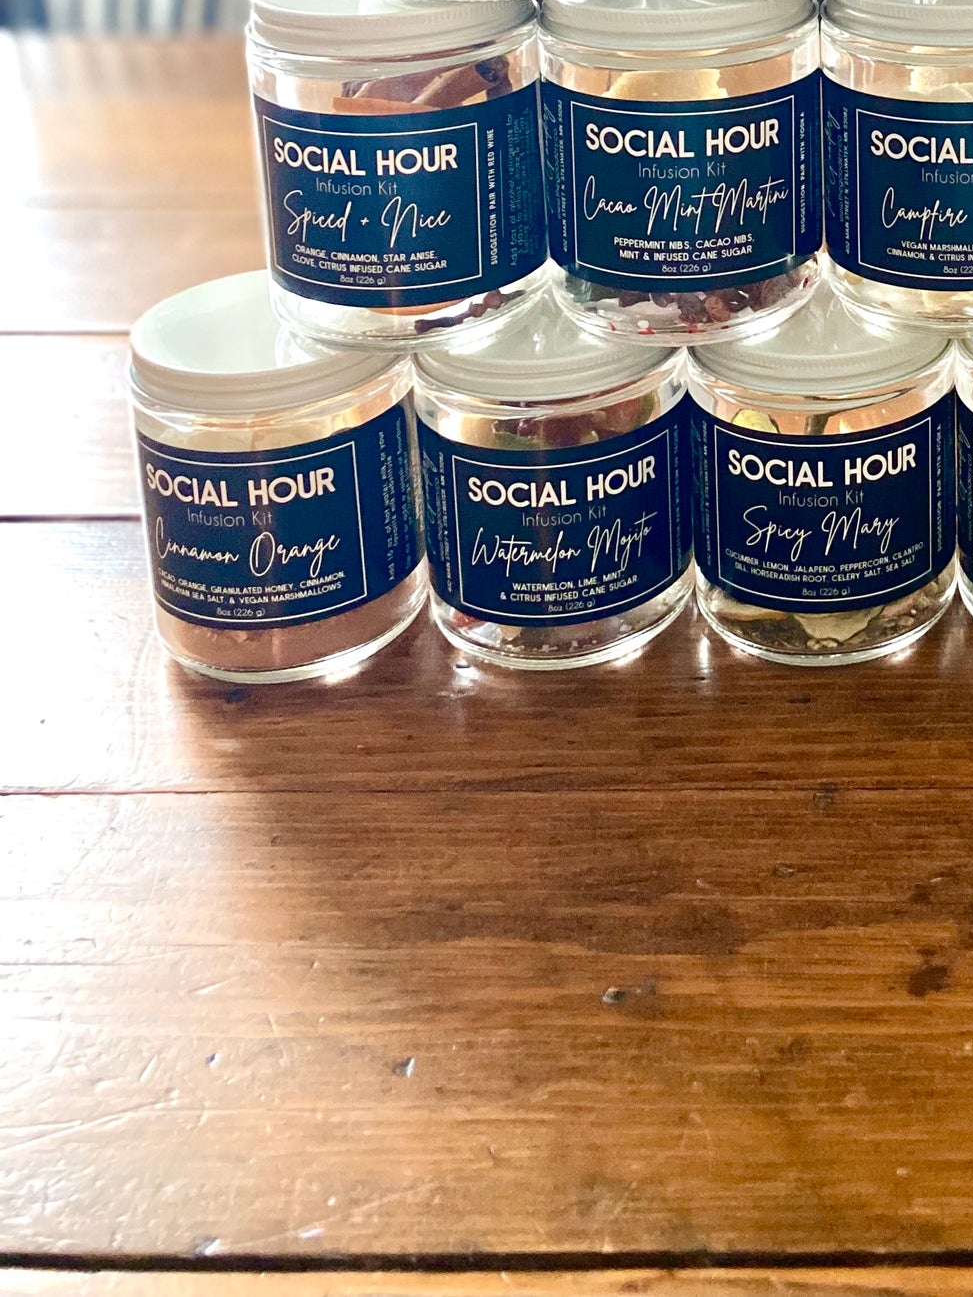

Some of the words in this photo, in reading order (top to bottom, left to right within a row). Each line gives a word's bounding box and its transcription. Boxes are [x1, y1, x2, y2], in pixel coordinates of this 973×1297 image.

[486, 128, 494, 149] WINE
[585, 123, 694, 158] SOCIAL
[706, 118, 779, 156] HOUR
[273, 137, 366, 176] SOCIAL
[376, 144, 458, 176] HOUR
[487, 151, 495, 167] RED
[487, 168, 496, 189] WITH
[638, 163, 700, 179] Infusion
[706, 162, 726, 177] Kit
[316, 178, 372, 196] Infusion
[379, 182, 398, 196] Kit
[488, 190, 497, 210] PAIR
[583, 175, 637, 220] Cacao
[644, 185, 723, 235] Mint
[712, 176, 789, 233] Martini
[283, 189, 352, 243] Spiced
[381, 196, 451, 248] Nice
[881, 186, 967, 240] Campfire
[614, 237, 665, 249] PEPPERMINT
[669, 240, 692, 250] NIBS,
[695, 237, 731, 249] CACAO
[733, 233, 754, 245] NIBS,
[319, 260, 347, 272] CITRUS
[350, 264, 383, 274] INFUSED
[386, 263, 412, 274] CANE
[415, 260, 447, 271] SUGAR
[728, 449, 833, 488] SOCIAL
[845, 443, 917, 486] HOUR
[145, 462, 238, 508] SOCIAL
[248, 467, 336, 506] HOUR
[468, 477, 577, 508] SOCIAL
[587, 456, 656, 500] HOUR
[779, 490, 839, 507] Infusion
[846, 489, 864, 504] Kit
[188, 507, 245, 527] Infusion
[252, 511, 273, 526] Kit
[522, 513, 582, 527] Infusion
[589, 506, 607, 521] Kit
[743, 505, 813, 562] Spicy
[821, 507, 900, 556] Mary
[155, 516, 240, 564] Cinnamon
[249, 531, 341, 577] Orange
[471, 526, 581, 577] Watermelon
[587, 512, 658, 573] Mojito
[512, 580, 576, 591] WATERMELON,
